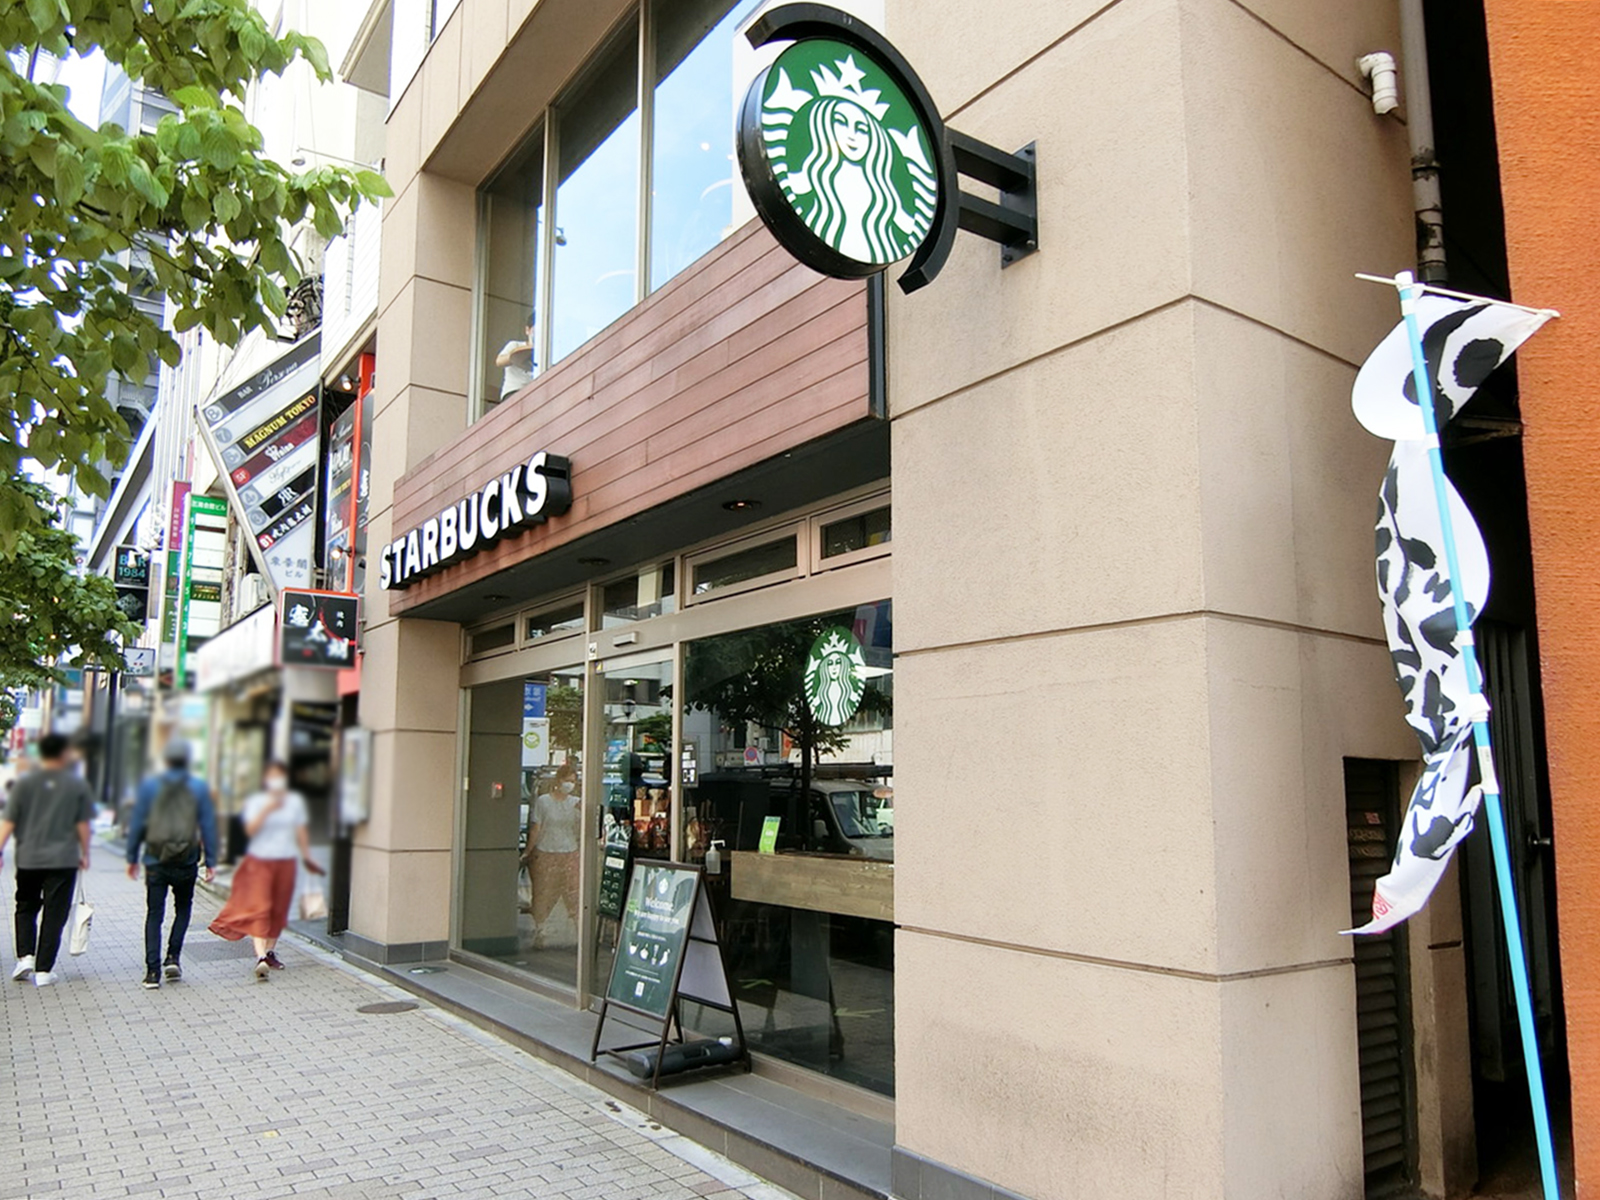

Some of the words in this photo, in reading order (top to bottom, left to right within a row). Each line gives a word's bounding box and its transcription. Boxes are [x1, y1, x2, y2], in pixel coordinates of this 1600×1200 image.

[237, 386, 254, 399] BAR
[244, 415, 288, 449] MAGNUM
[285, 395, 316, 420] TOKYO
[379, 451, 548, 590] STARBUCKS
[259, 535, 274, 549] B1
[119, 555, 146, 567] BR
[118, 566, 146, 578] 1984
[285, 569, 304, 579] ビル
